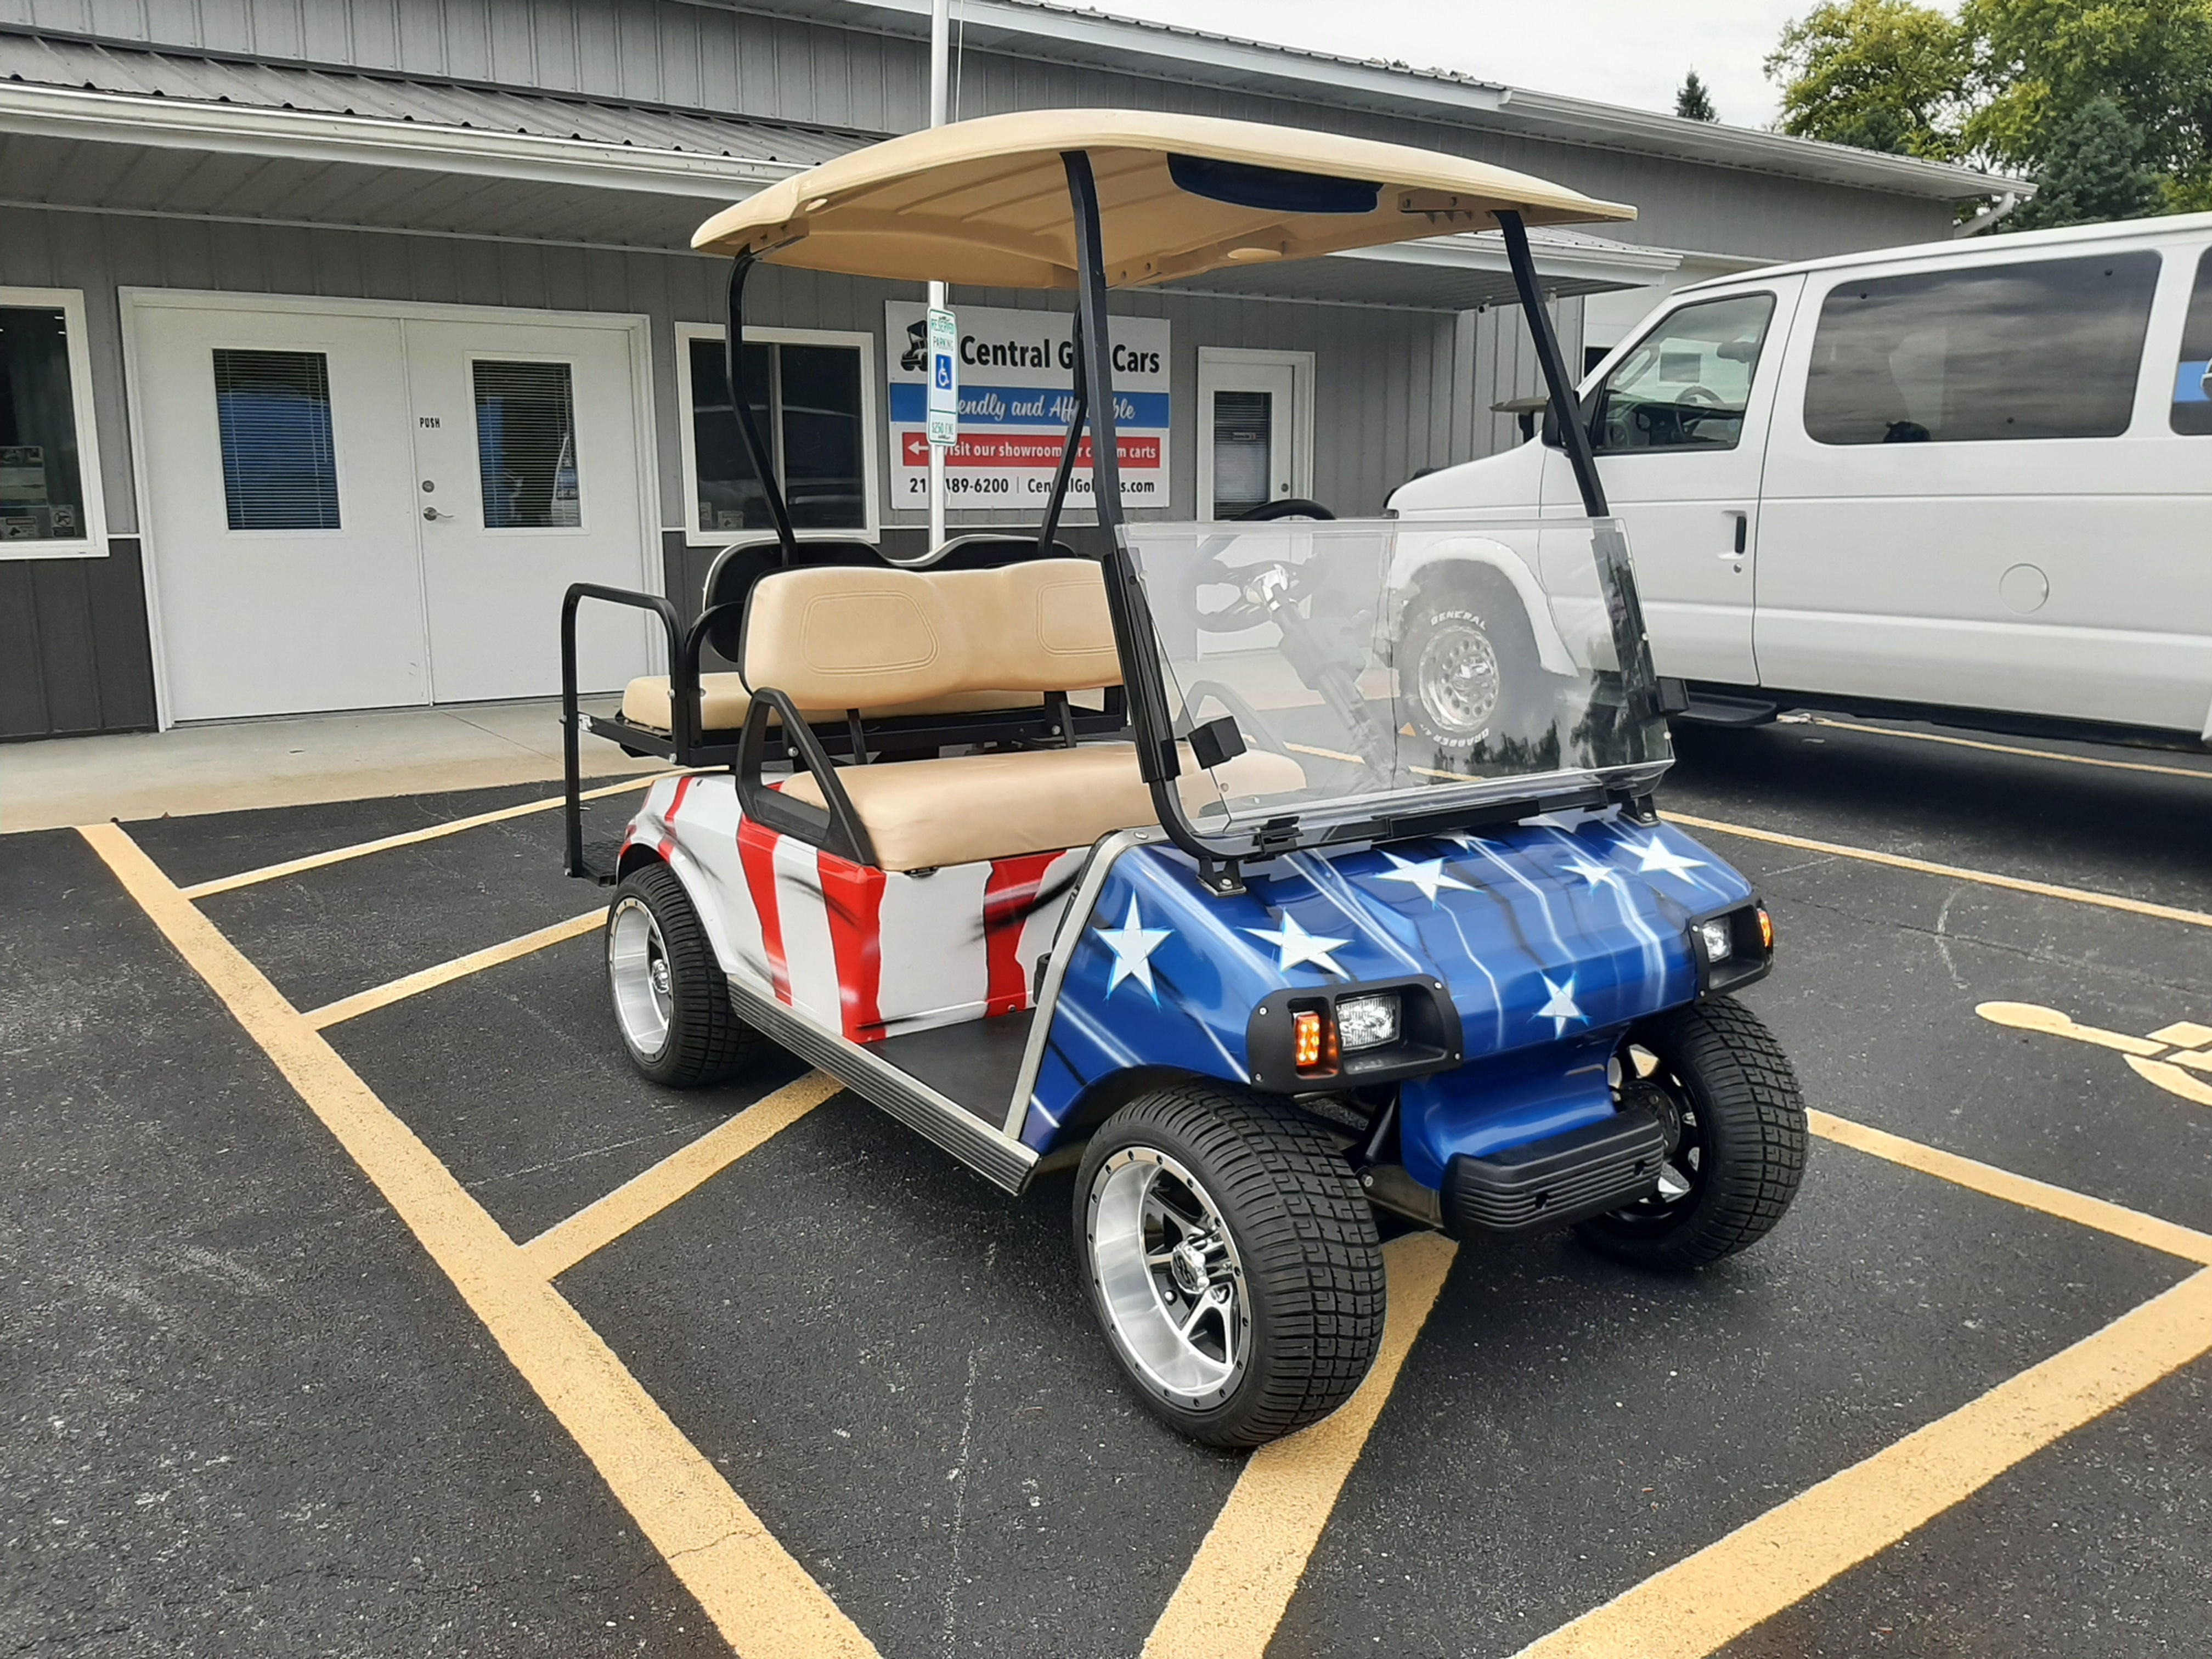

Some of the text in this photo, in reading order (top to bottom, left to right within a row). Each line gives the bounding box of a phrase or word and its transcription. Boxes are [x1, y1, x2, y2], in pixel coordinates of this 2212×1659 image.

[961, 336, 1050, 368] Central
[1113, 344, 1160, 373] Cars
[958, 393, 1136, 422] endly and Affble
[420, 416, 441, 428] PUSH
[974, 445, 996, 456] our
[998, 442, 1062, 458] showroom
[1129, 445, 1156, 458] carts
[1431, 611, 1486, 631] GENERAL
